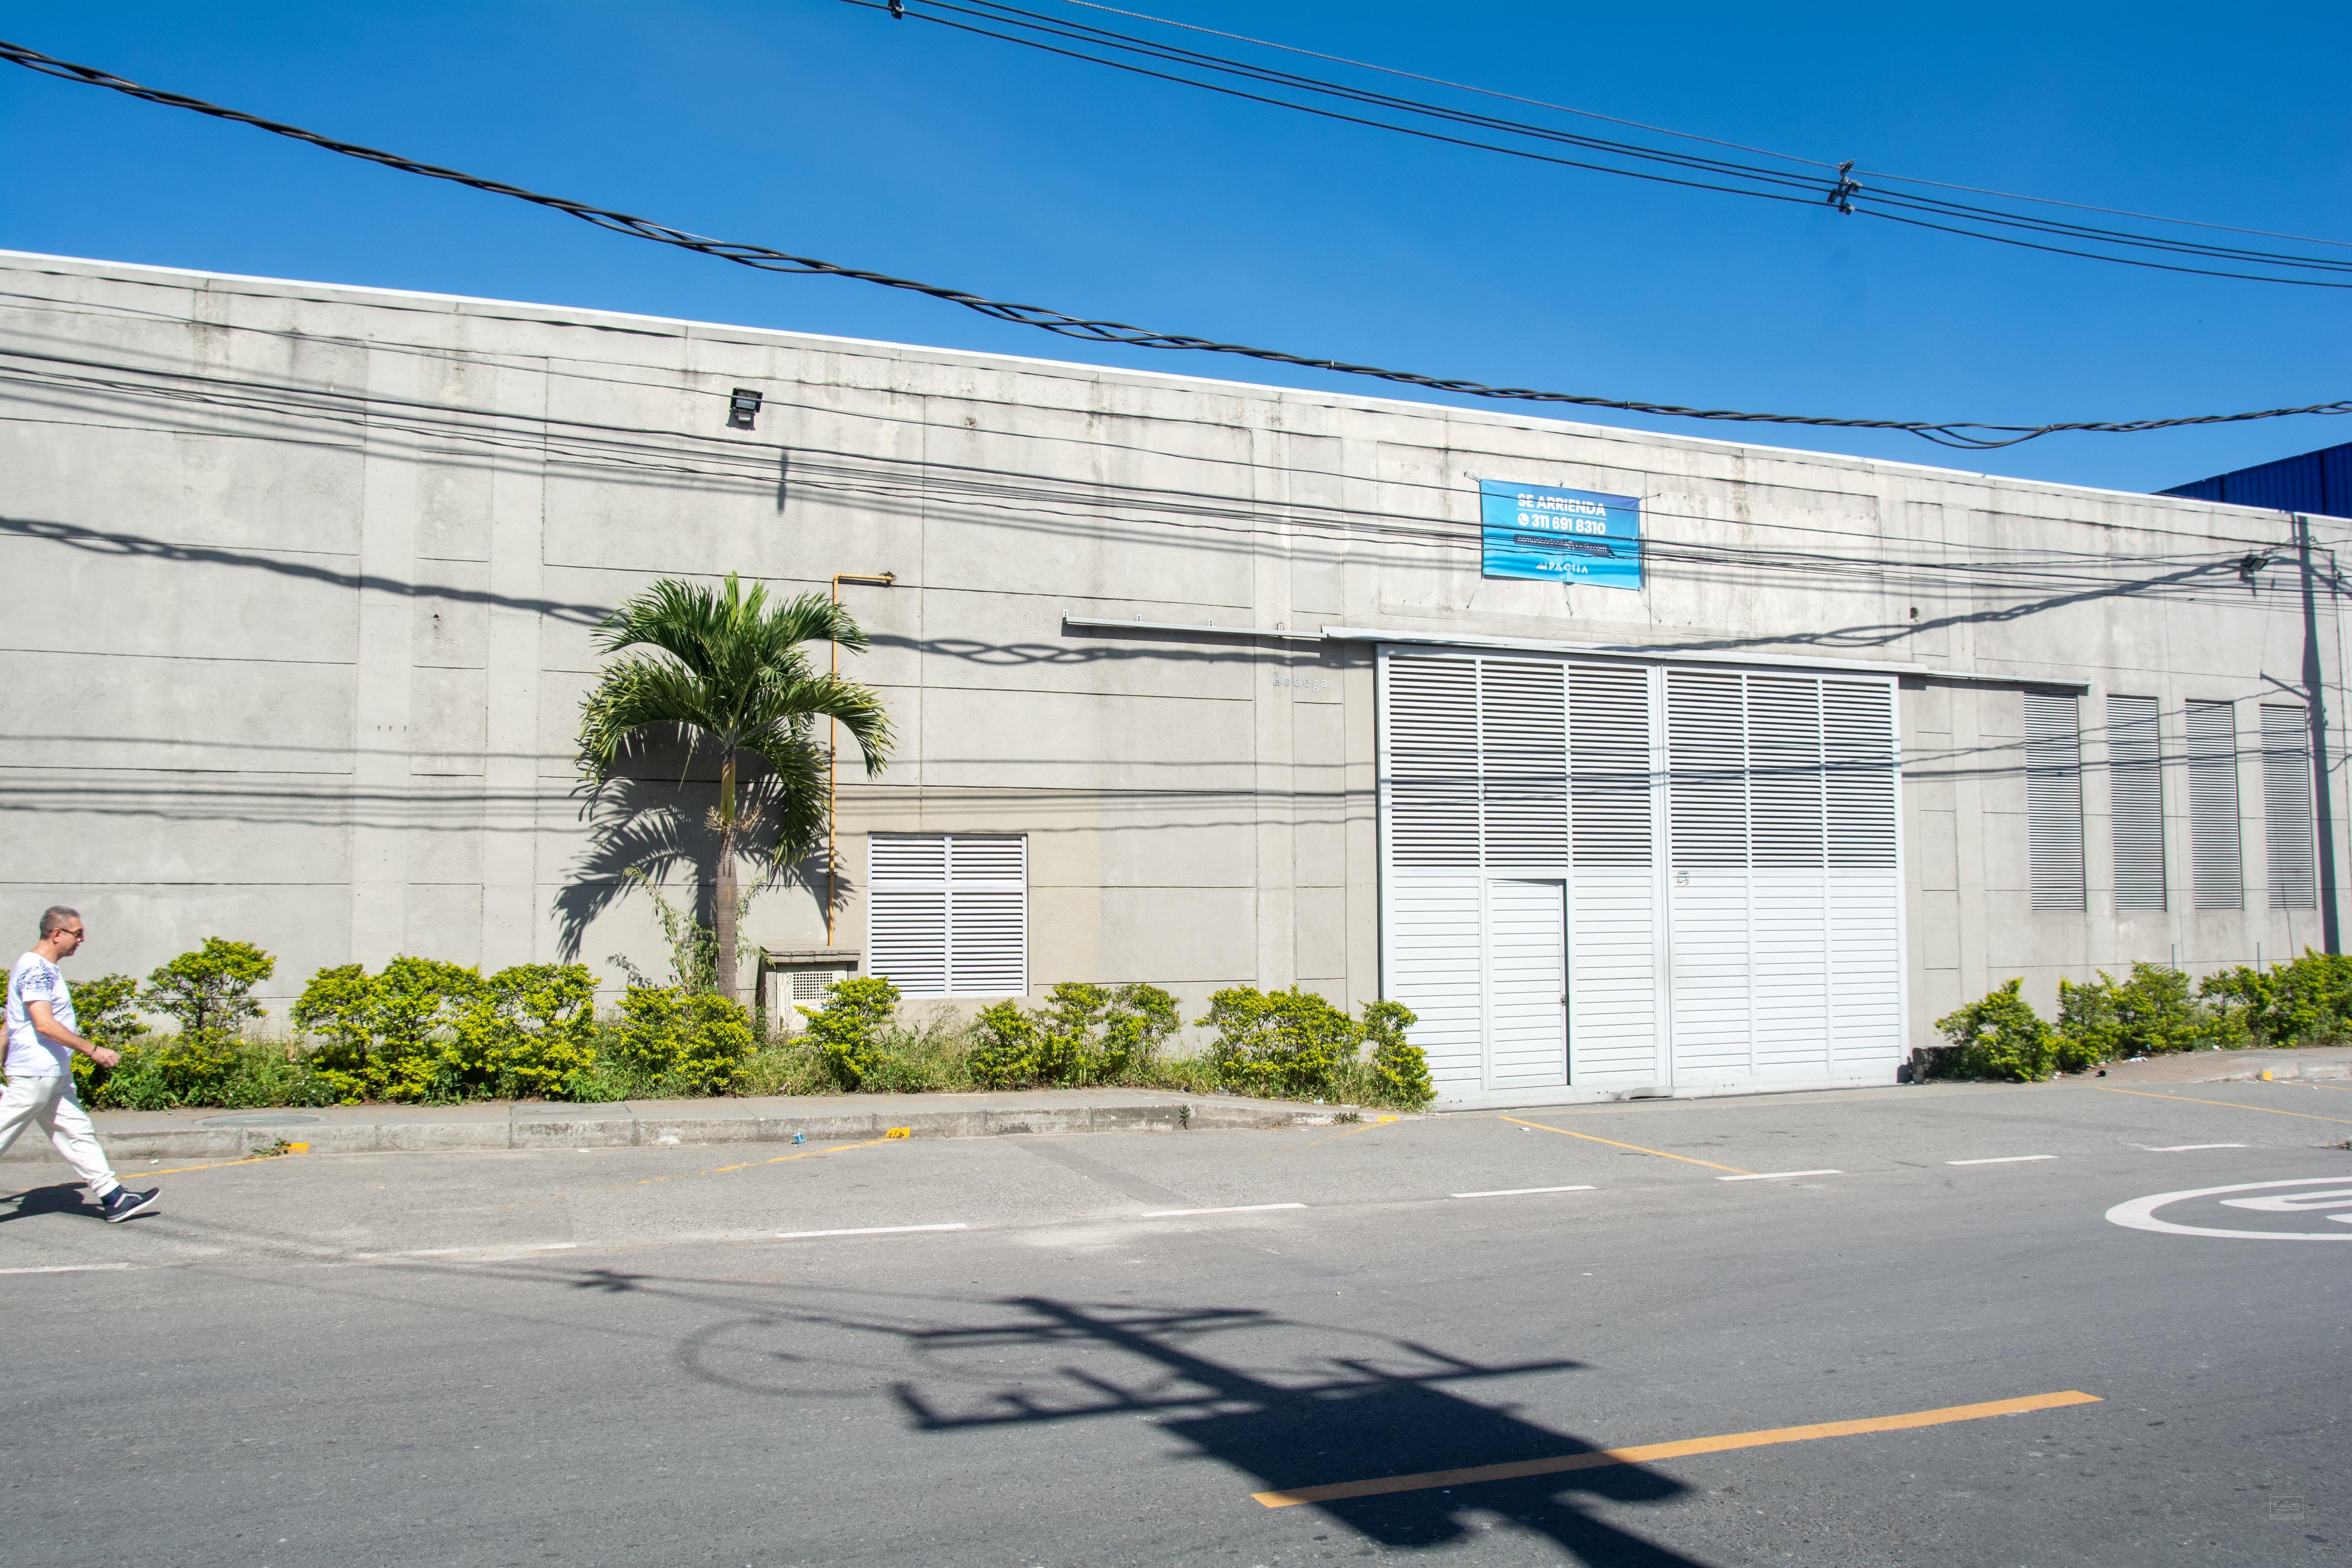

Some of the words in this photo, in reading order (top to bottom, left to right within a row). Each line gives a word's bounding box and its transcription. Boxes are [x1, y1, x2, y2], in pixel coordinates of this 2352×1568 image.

[1517, 494, 1534, 508] SE
[1536, 496, 1606, 516] ARRIENDA
[1532, 514, 1549, 528] 311
[1552, 516, 1572, 531] 691
[1575, 519, 1606, 535] 8310
[1549, 562, 1588, 574] PACTIA
[1272, 673, 1328, 692] Bodega
